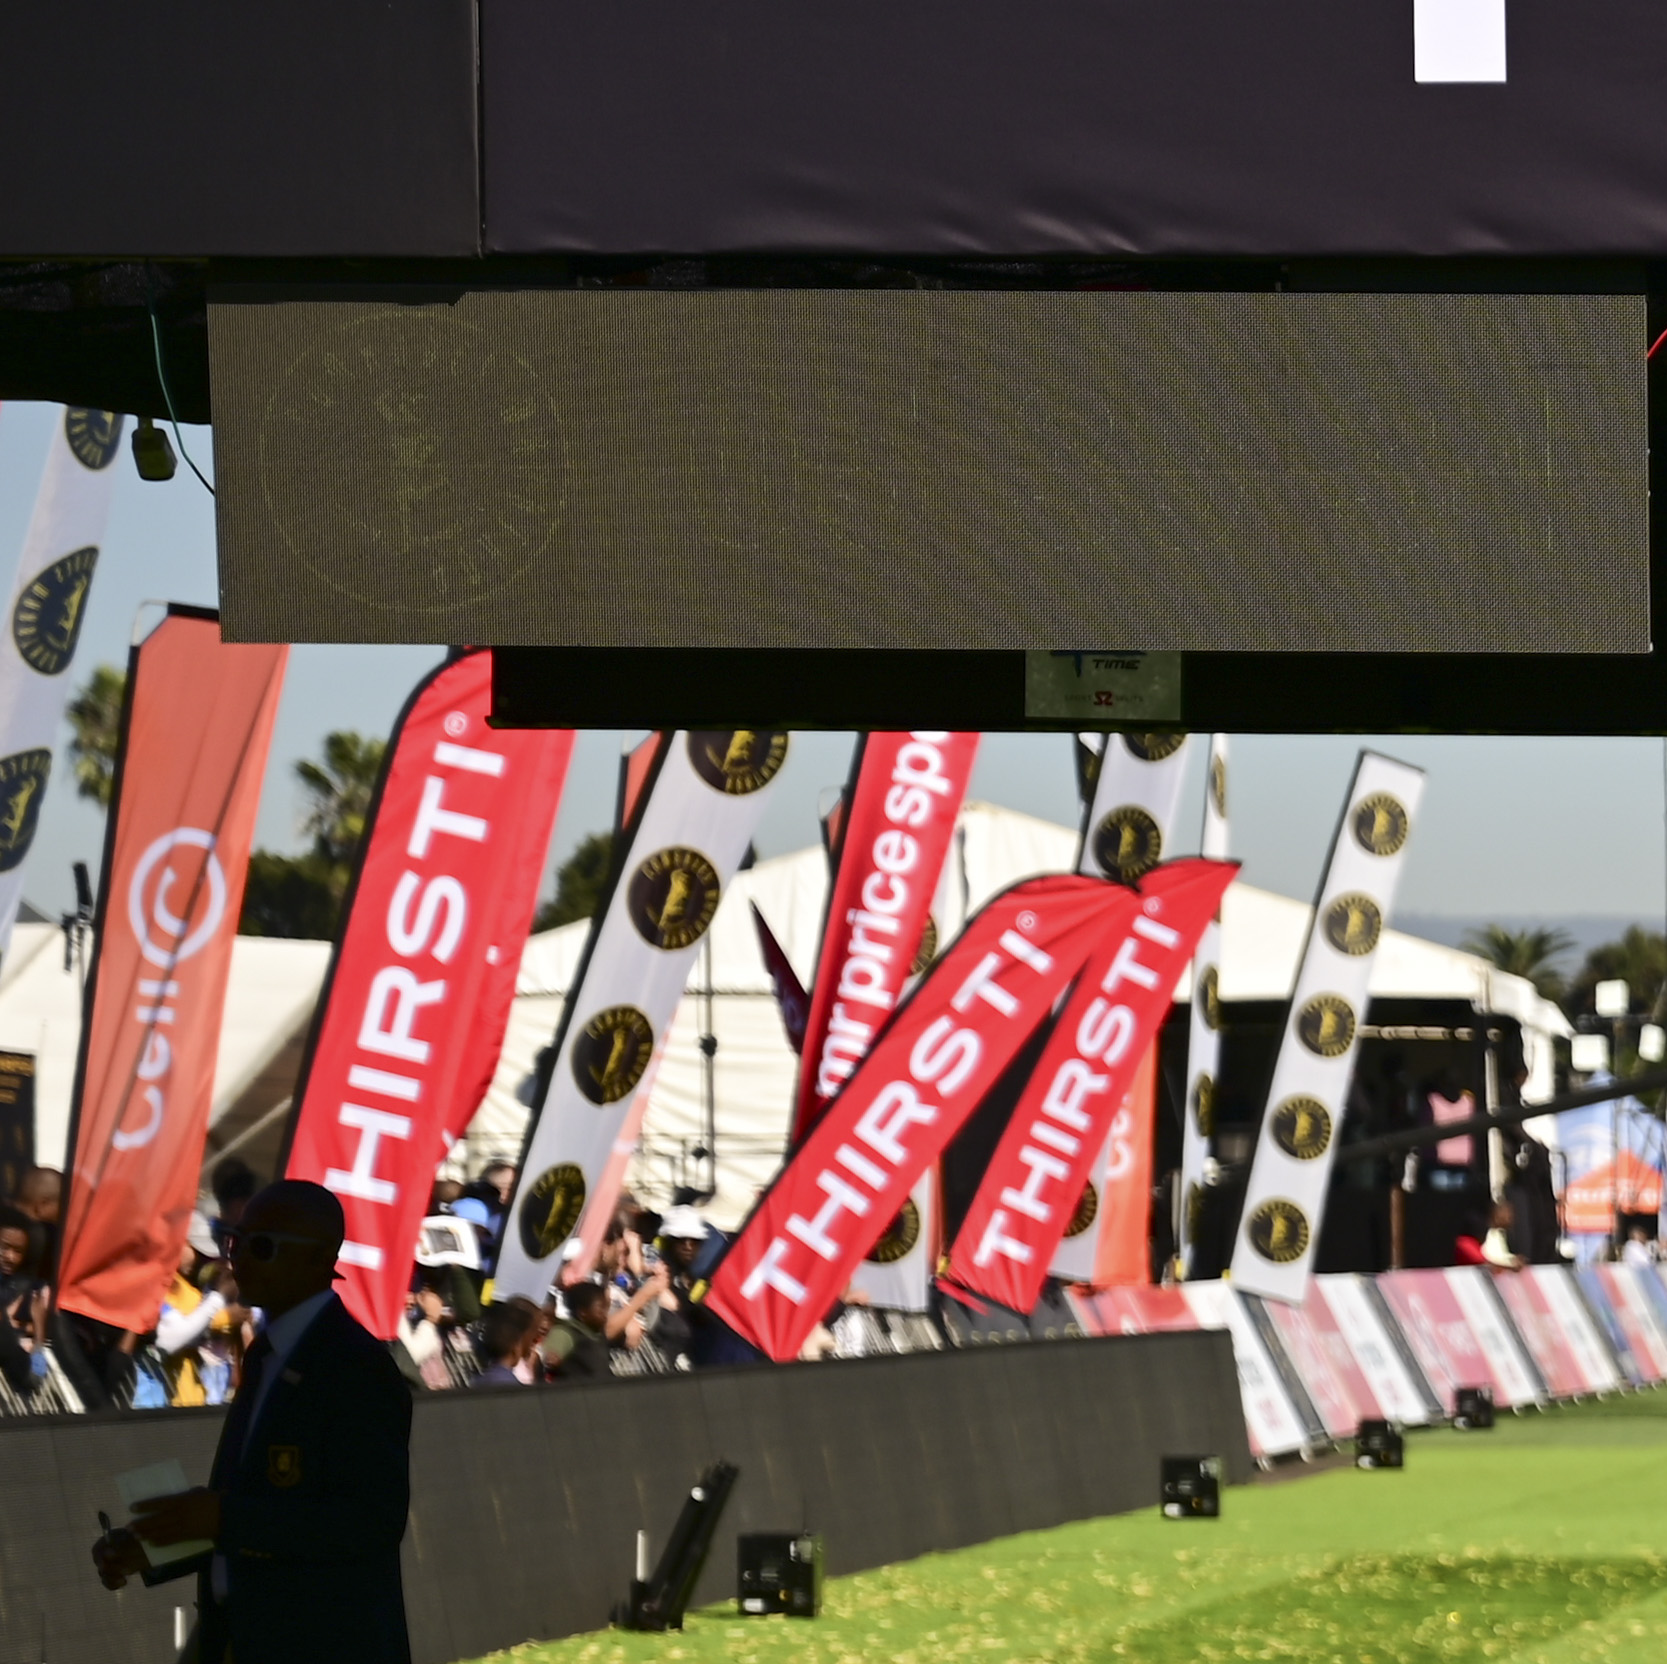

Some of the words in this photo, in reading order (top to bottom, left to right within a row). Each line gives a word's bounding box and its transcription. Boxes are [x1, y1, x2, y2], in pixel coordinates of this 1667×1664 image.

[838, 821, 917, 1009] price
[973, 914, 1180, 1269] THIRSTI
[740, 929, 1054, 1306] THIRSTI
